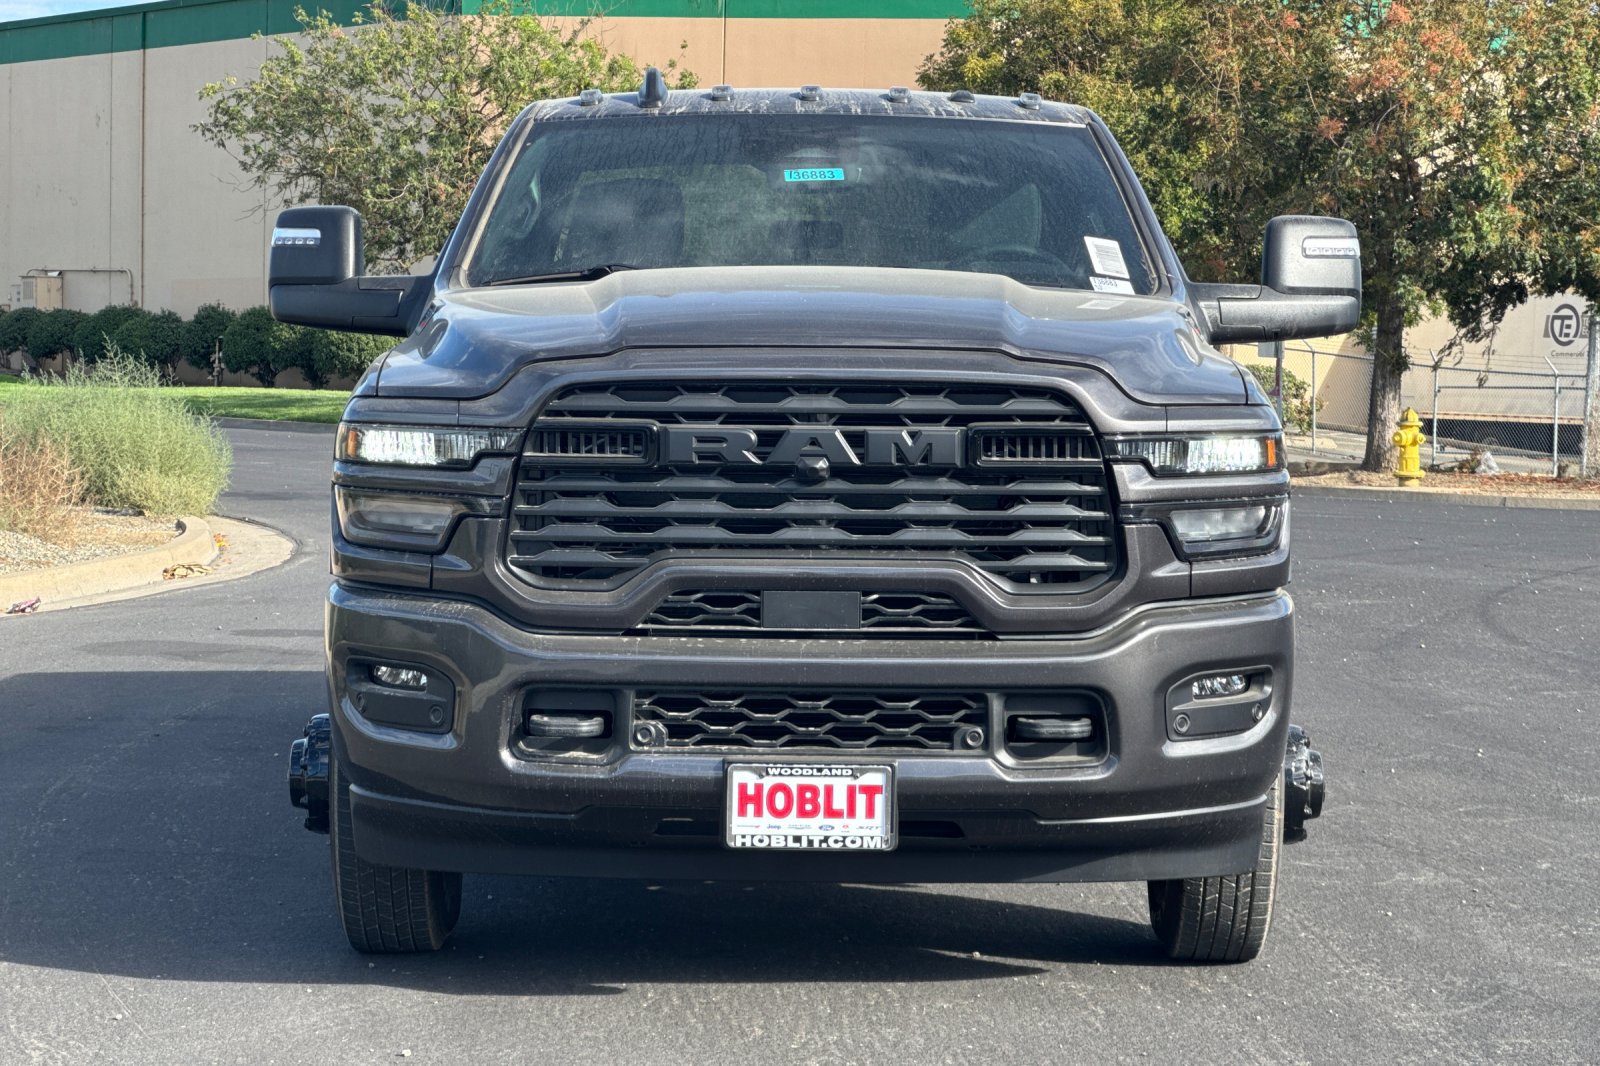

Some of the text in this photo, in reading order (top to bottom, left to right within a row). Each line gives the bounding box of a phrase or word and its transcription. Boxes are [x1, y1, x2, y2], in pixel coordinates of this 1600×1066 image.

[790, 170, 835, 180] 136883
[666, 427, 966, 467] RAM
[767, 767, 853, 776] WOODLAND
[738, 783, 883, 819] HOBLIT
[735, 834, 881, 848] HOBLIT.COM
